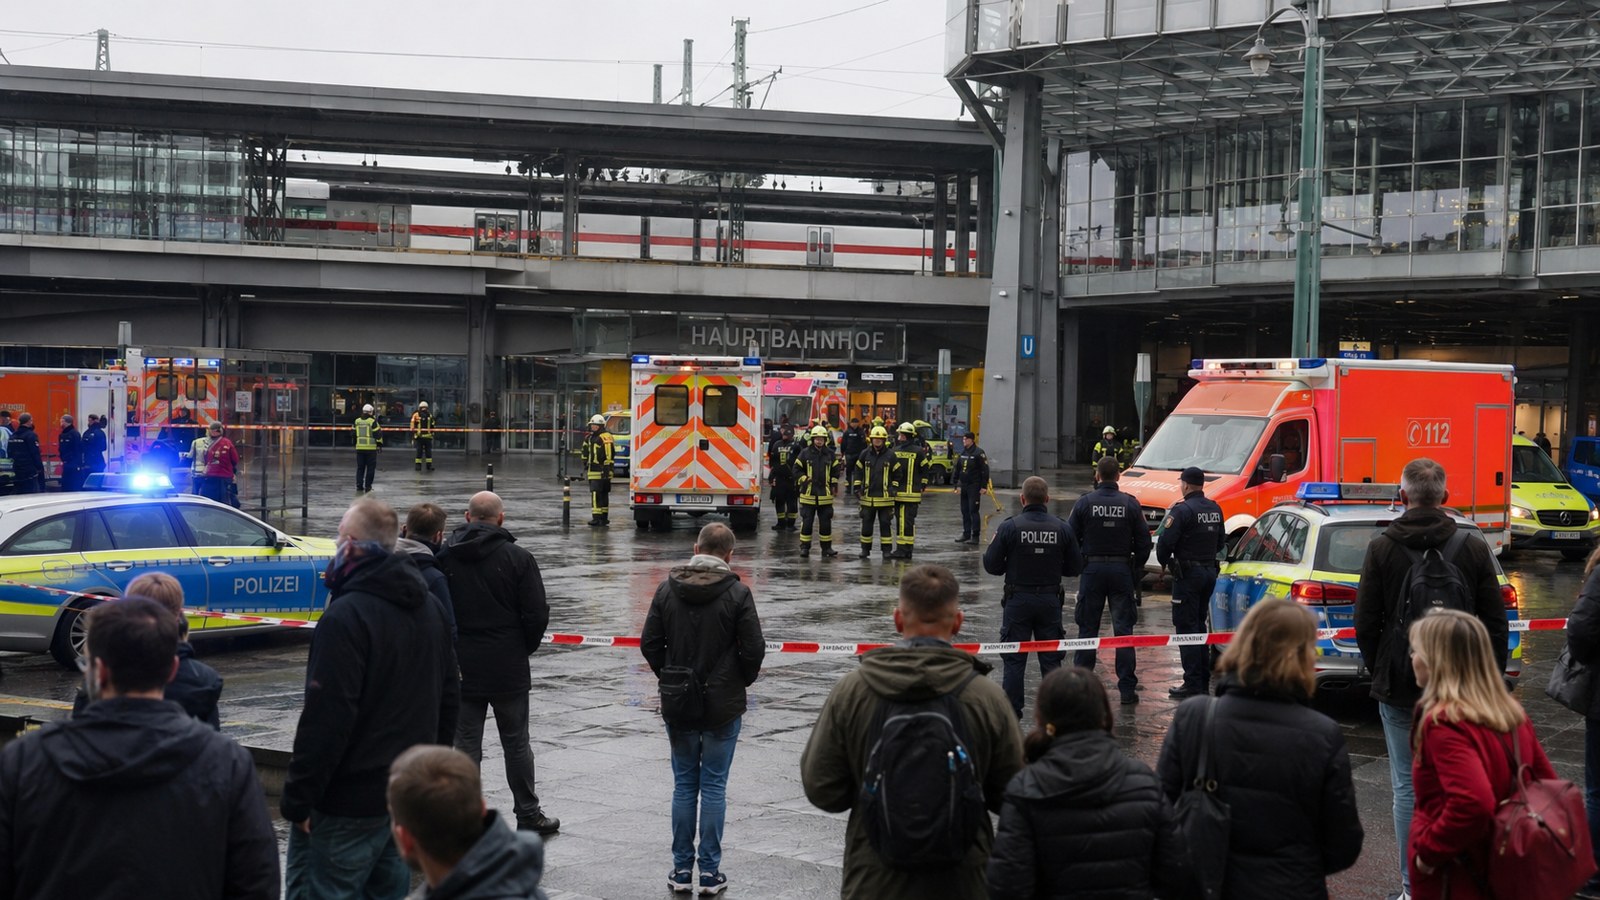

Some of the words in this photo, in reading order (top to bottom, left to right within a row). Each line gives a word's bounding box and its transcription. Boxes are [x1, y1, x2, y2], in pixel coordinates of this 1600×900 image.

[691, 326, 884, 351] HAUPTBAHNHOF
[1024, 337, 1033, 355] U
[1425, 422, 1450, 444] 112
[1092, 505, 1125, 517] POLIZEI
[1021, 531, 1057, 544] POLIZEI
[233, 575, 299, 595] POLIZEI
